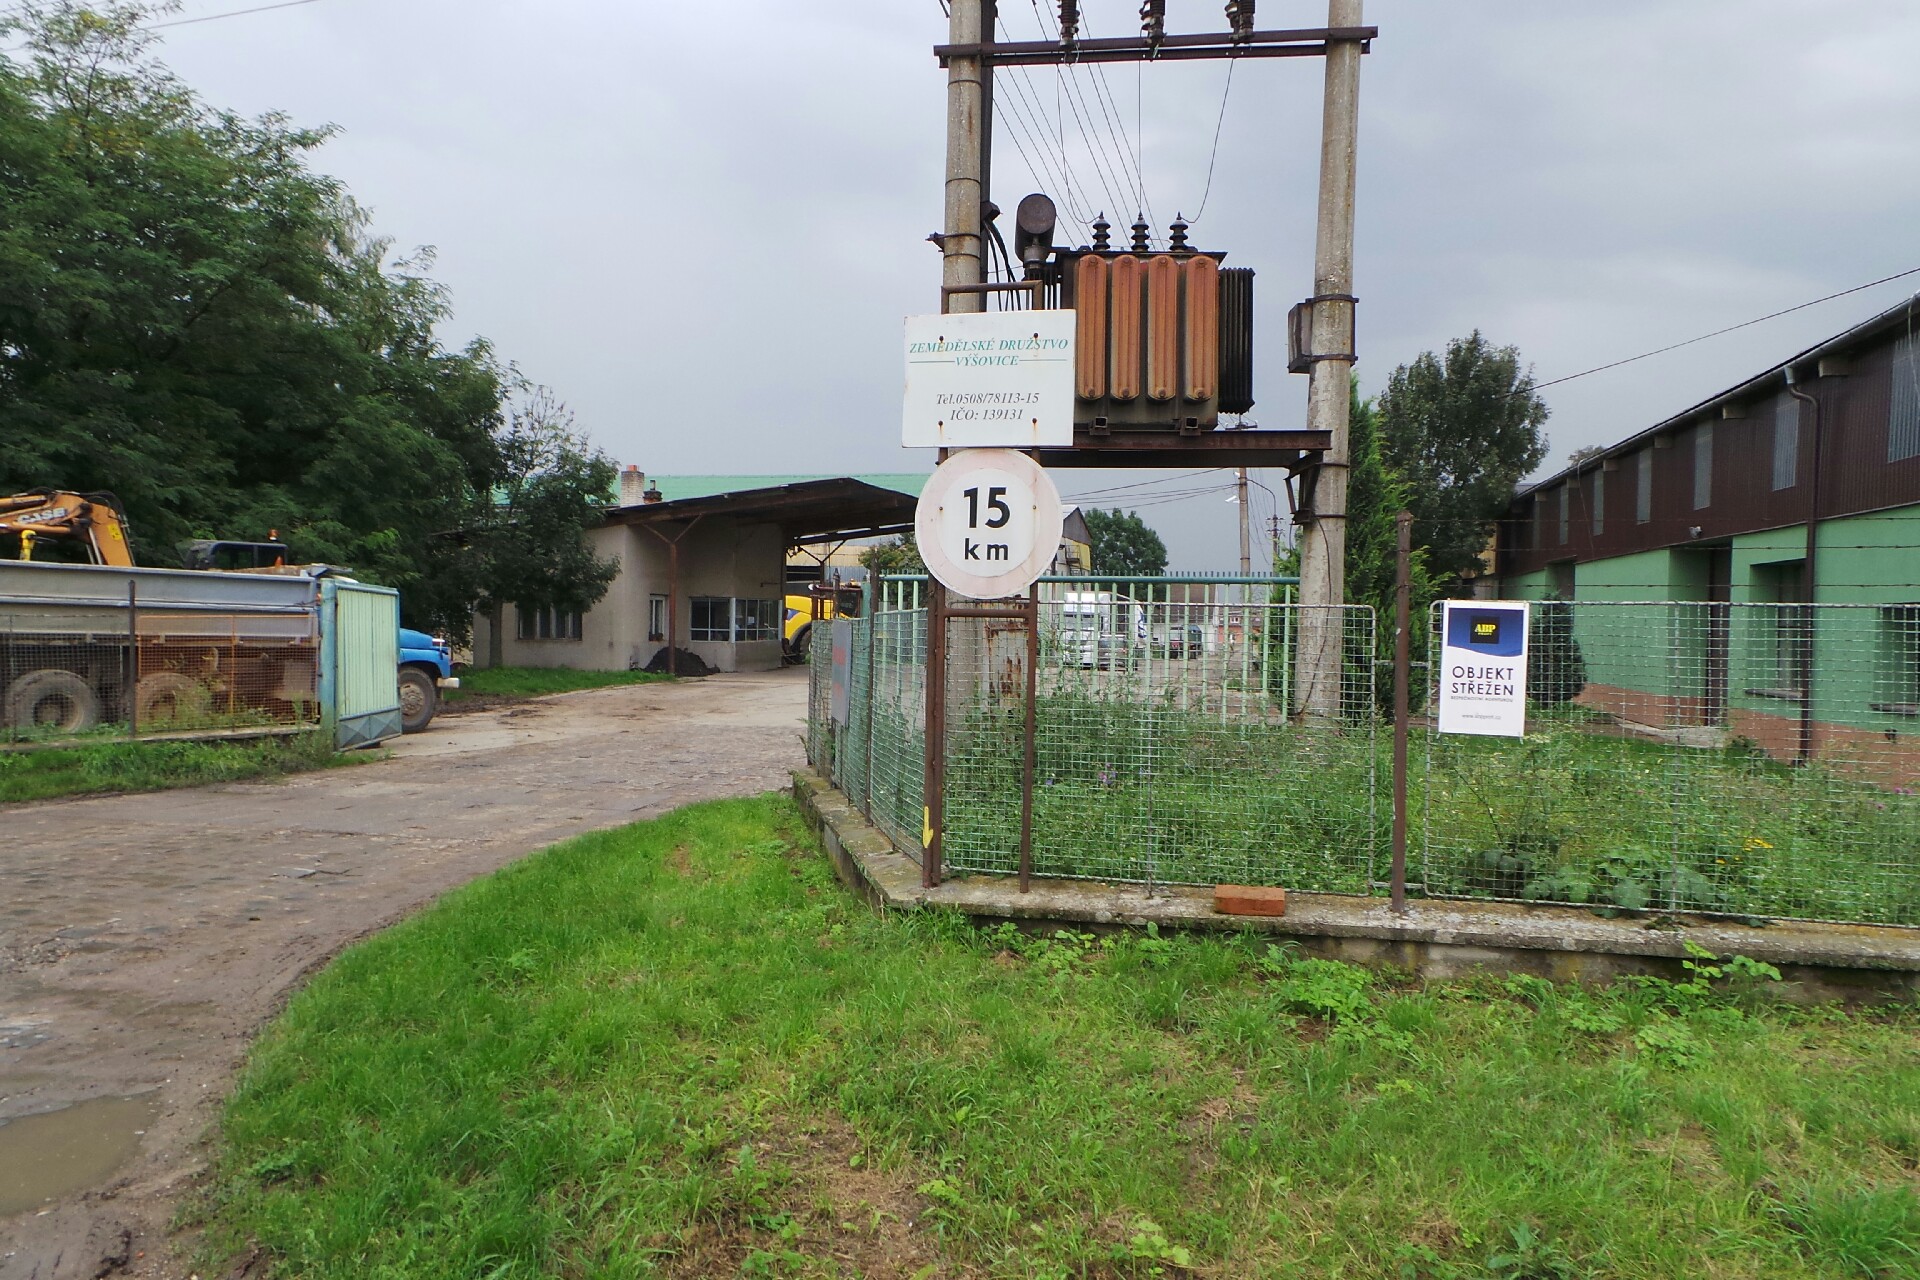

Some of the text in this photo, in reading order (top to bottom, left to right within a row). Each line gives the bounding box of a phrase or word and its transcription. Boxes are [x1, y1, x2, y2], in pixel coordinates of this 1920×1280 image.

[999, 337, 1069, 351] DRUŽSTVO
[955, 353, 1020, 367] VÝŠOVICE
[936, 392, 1040, 405] Tel.0508/78113-15
[950, 407, 1024, 421] IČO: 139131
[963, 486, 1011, 529] 15
[17, 507, 68, 524] CASE
[964, 537, 1009, 561] km
[1452, 665, 1514, 681] OBJEKT
[1451, 680, 1514, 695] STŘEŽEN
